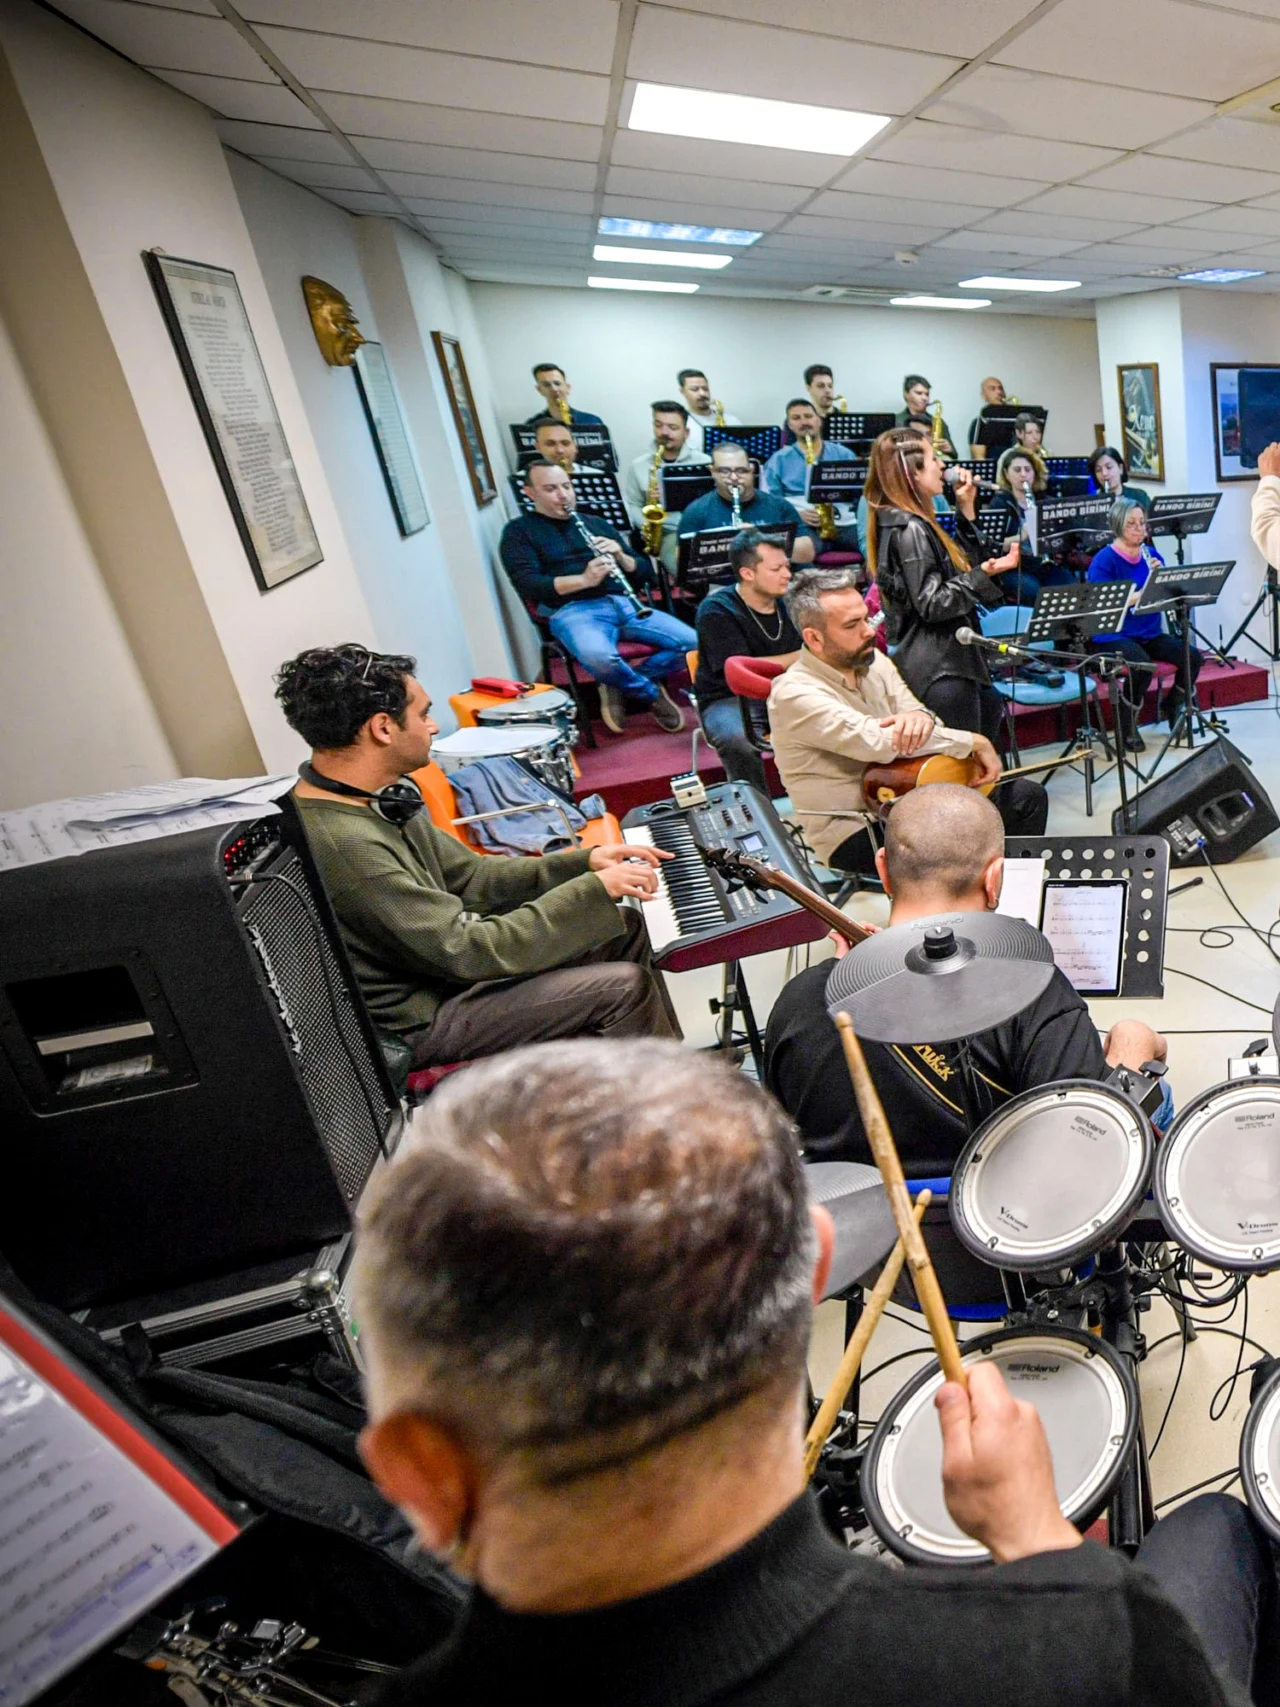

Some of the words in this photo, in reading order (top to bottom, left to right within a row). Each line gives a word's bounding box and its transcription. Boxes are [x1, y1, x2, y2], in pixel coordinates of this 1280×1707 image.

[1154, 503, 1184, 512] BANDO
[1042, 508, 1077, 520] BANDO
[699, 544, 731, 555] BAN
[1155, 573, 1190, 584] BANDO
[1245, 1112, 1275, 1121] Roland
[1083, 1118, 1107, 1136] Roland
[1021, 1363, 1060, 1373] Roland
